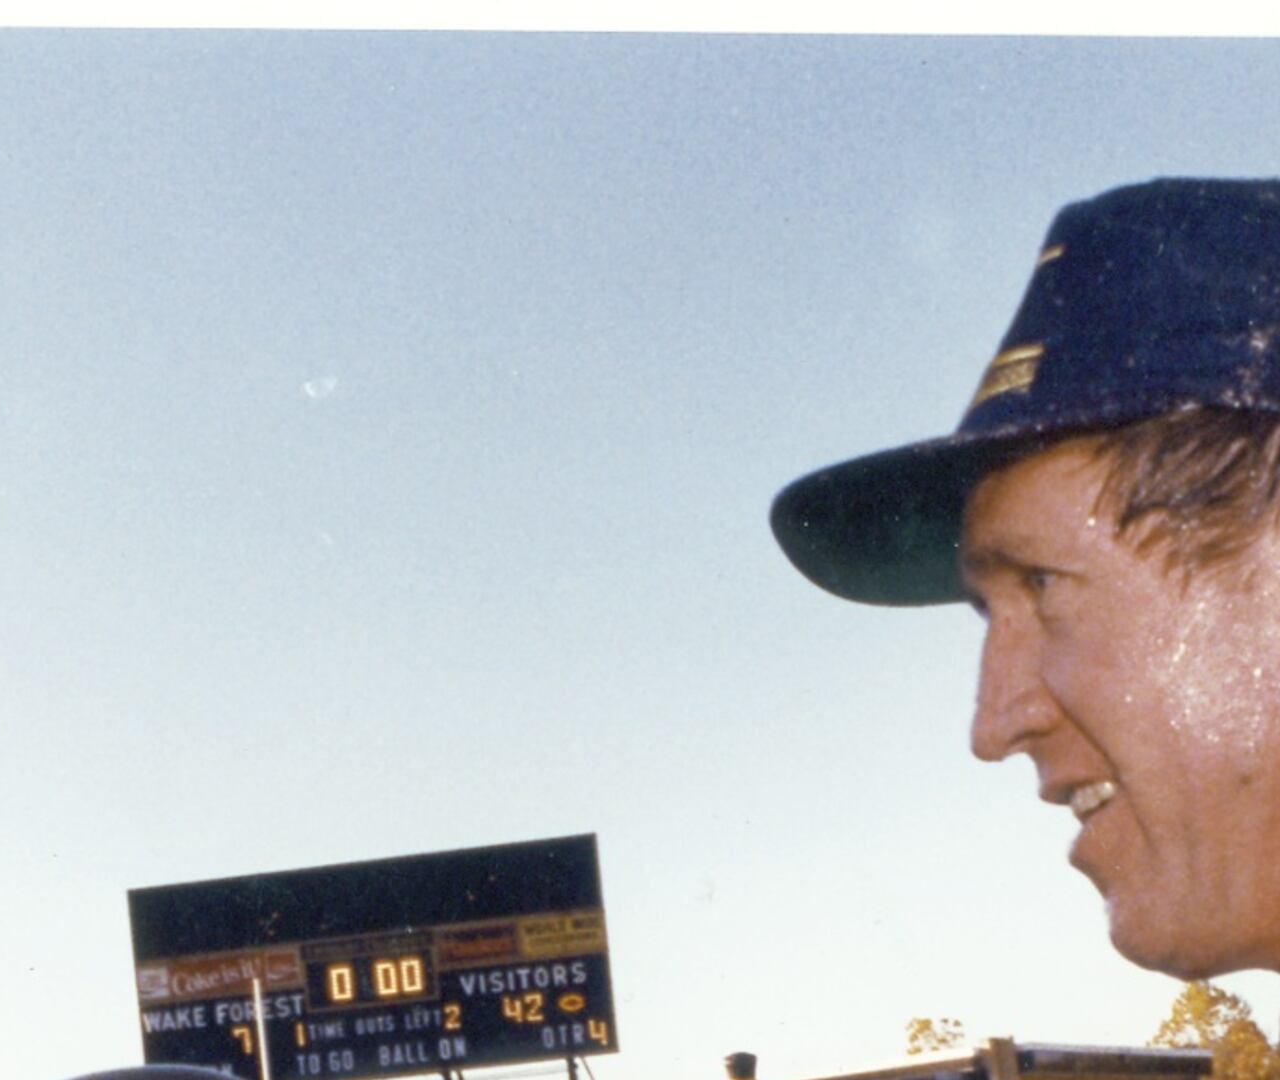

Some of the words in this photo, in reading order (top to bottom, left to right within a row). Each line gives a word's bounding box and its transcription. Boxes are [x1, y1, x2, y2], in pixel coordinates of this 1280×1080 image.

[327, 964, 354, 1001] 0
[459, 962, 587, 996] VISITORS
[142, 1004, 207, 1034] WAKE
[444, 1004, 462, 1030] 2
[502, 992, 544, 1023] 42
[232, 1024, 253, 1054] 7
[295, 1021, 307, 1048] 1
[308, 1021, 345, 1041] TIME
[355, 1014, 395, 1036] OUTS
[404, 1007, 442, 1031] LEFT
[587, 1018, 609, 1047] 4
[296, 1053, 321, 1075] TO
[379, 1042, 429, 1067] BALL
[439, 1037, 466, 1060] ON
